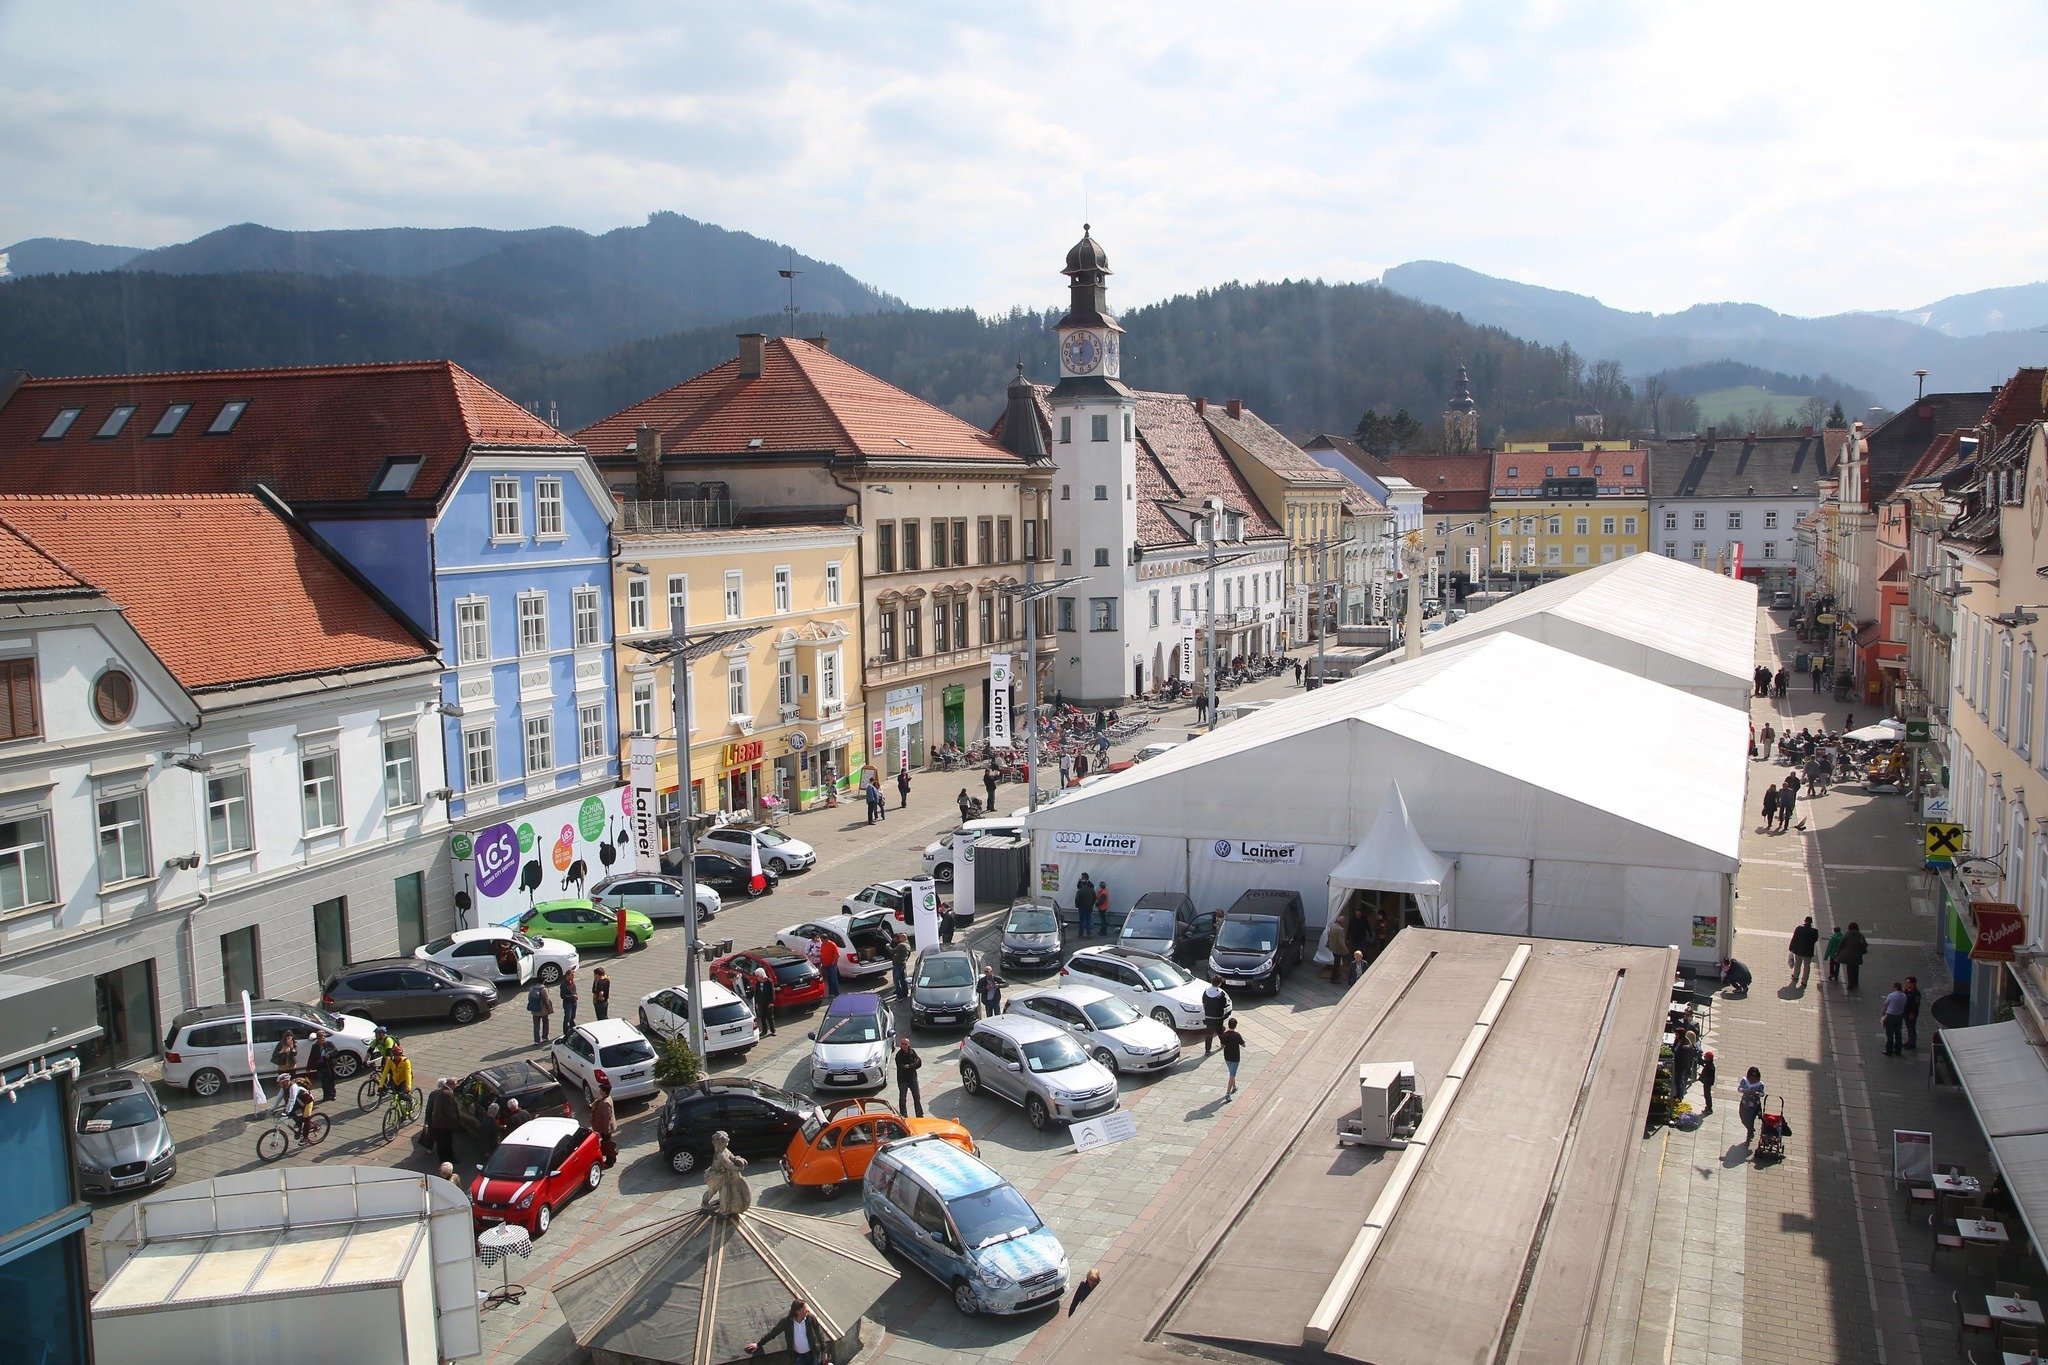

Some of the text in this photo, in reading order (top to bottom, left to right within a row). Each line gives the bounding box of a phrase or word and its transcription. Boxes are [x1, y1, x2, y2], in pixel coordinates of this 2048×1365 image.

[1373, 582, 1383, 612] Huber
[1183, 637, 1193, 675] Laimer
[994, 688, 1006, 739] Laimer
[636, 787, 652, 859] Laimer
[647, 819, 656, 859] Autohaus
[1084, 833, 1136, 849] Laimer
[1241, 841, 1295, 858] Laimer
